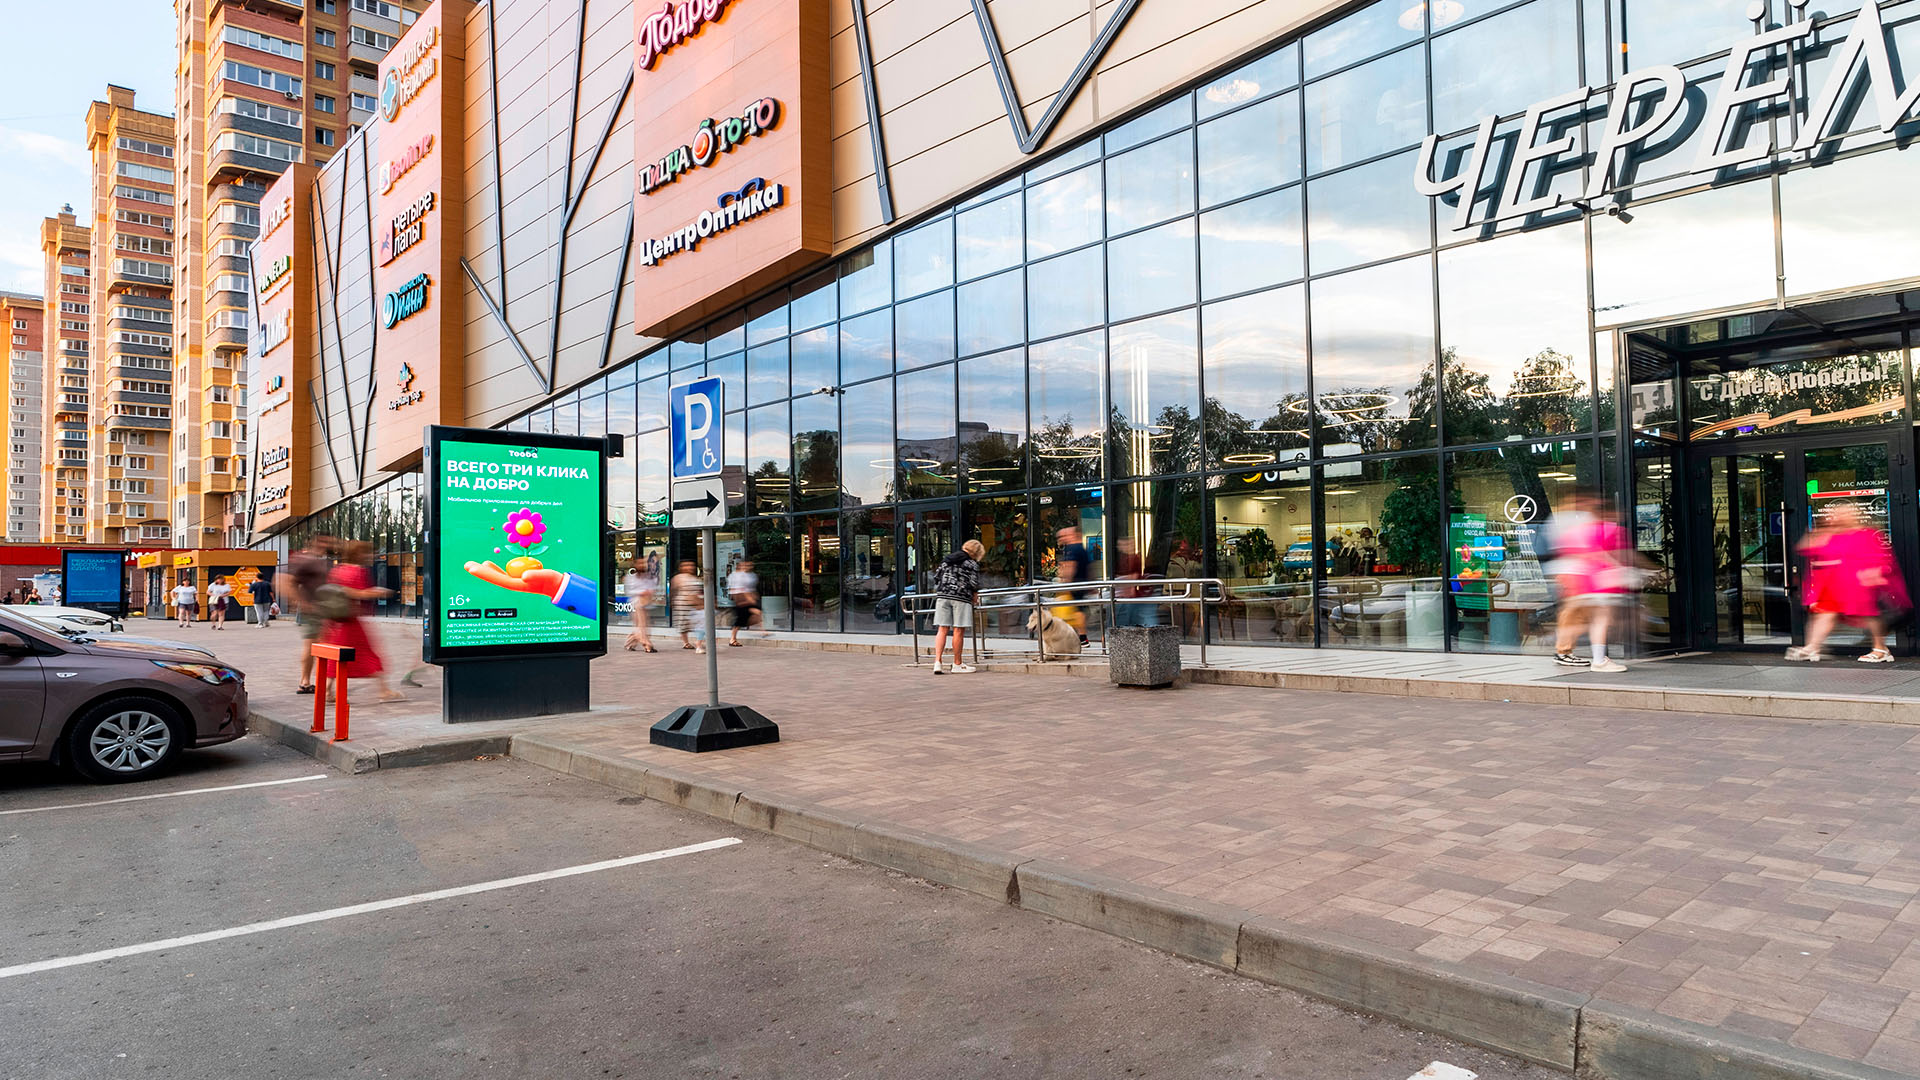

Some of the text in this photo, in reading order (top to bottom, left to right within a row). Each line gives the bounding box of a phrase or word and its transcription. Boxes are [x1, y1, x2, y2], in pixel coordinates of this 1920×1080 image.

[638, 0, 727, 69] Подру
[639, 183, 779, 266] ЦентрОптика
[1788, 359, 1889, 391] Победы!
[447, 460, 590, 479] ВСЕГО ТРИ КЛИКА
[447, 476, 530, 491] НА ДОБРО
[448, 594, 471, 606] 16+
